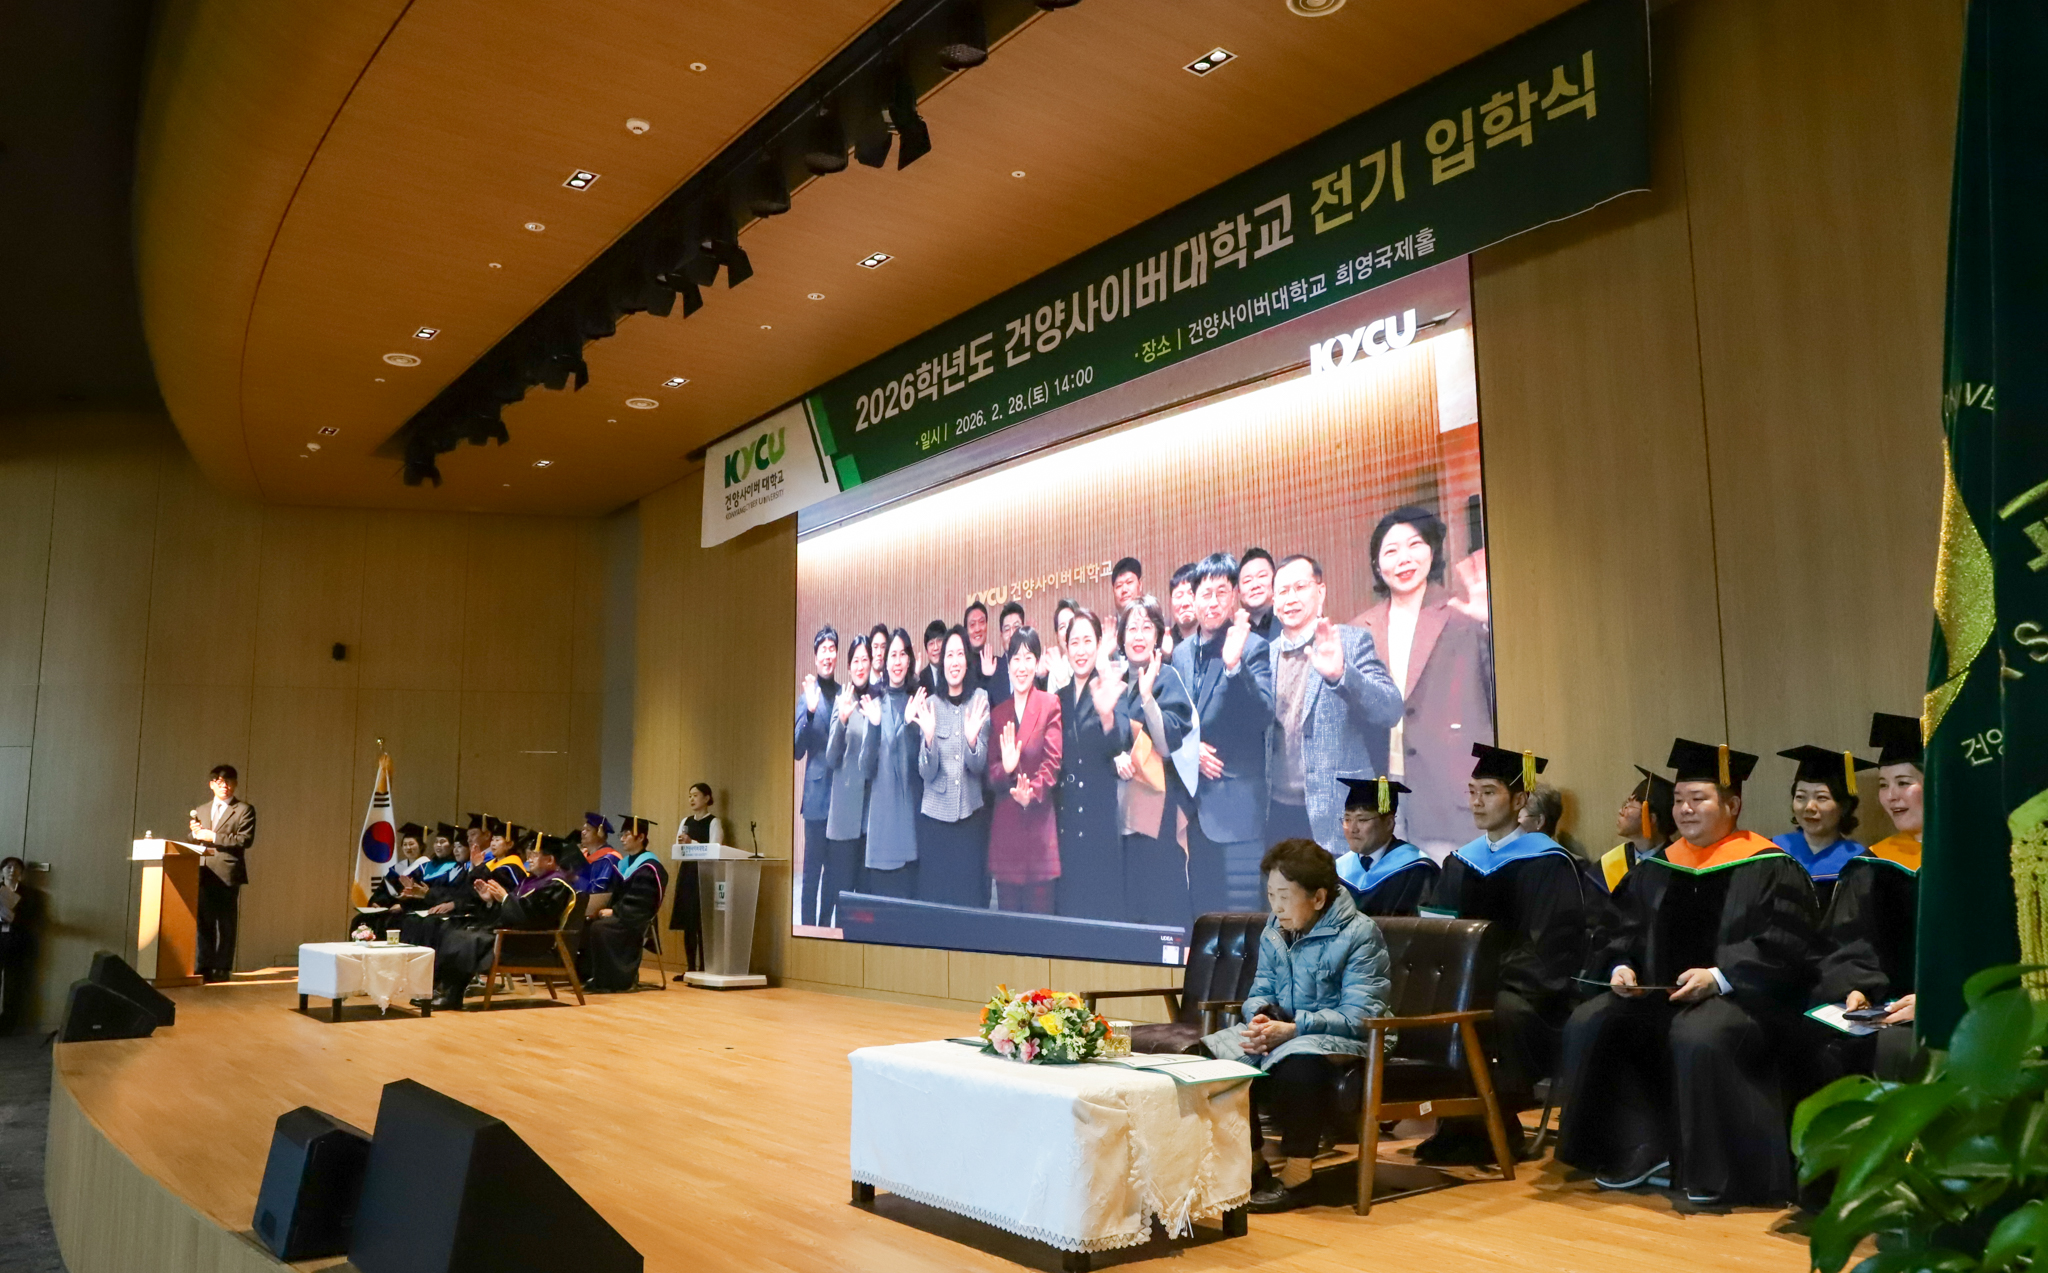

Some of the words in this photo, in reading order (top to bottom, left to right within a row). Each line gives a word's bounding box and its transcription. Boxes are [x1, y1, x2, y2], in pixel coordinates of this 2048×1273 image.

[855, 331, 994, 432] 2026학년도
[1004, 193, 1294, 368] 건양사이버대학교
[1310, 140, 1406, 235] 전기
[1424, 49, 1598, 186] 입학식
[1188, 273, 1327, 345] 건양사이버대학교
[1335, 227, 1436, 287] 희영국제홀
[1310, 308, 1417, 376] KYCU
[955, 410, 987, 435] 2026.
[991, 403, 1003, 421] 2.
[1054, 365, 1094, 396] 14:00
[724, 426, 786, 489] KYCU
[1010, 560, 1113, 602] 건양사이버대학교
